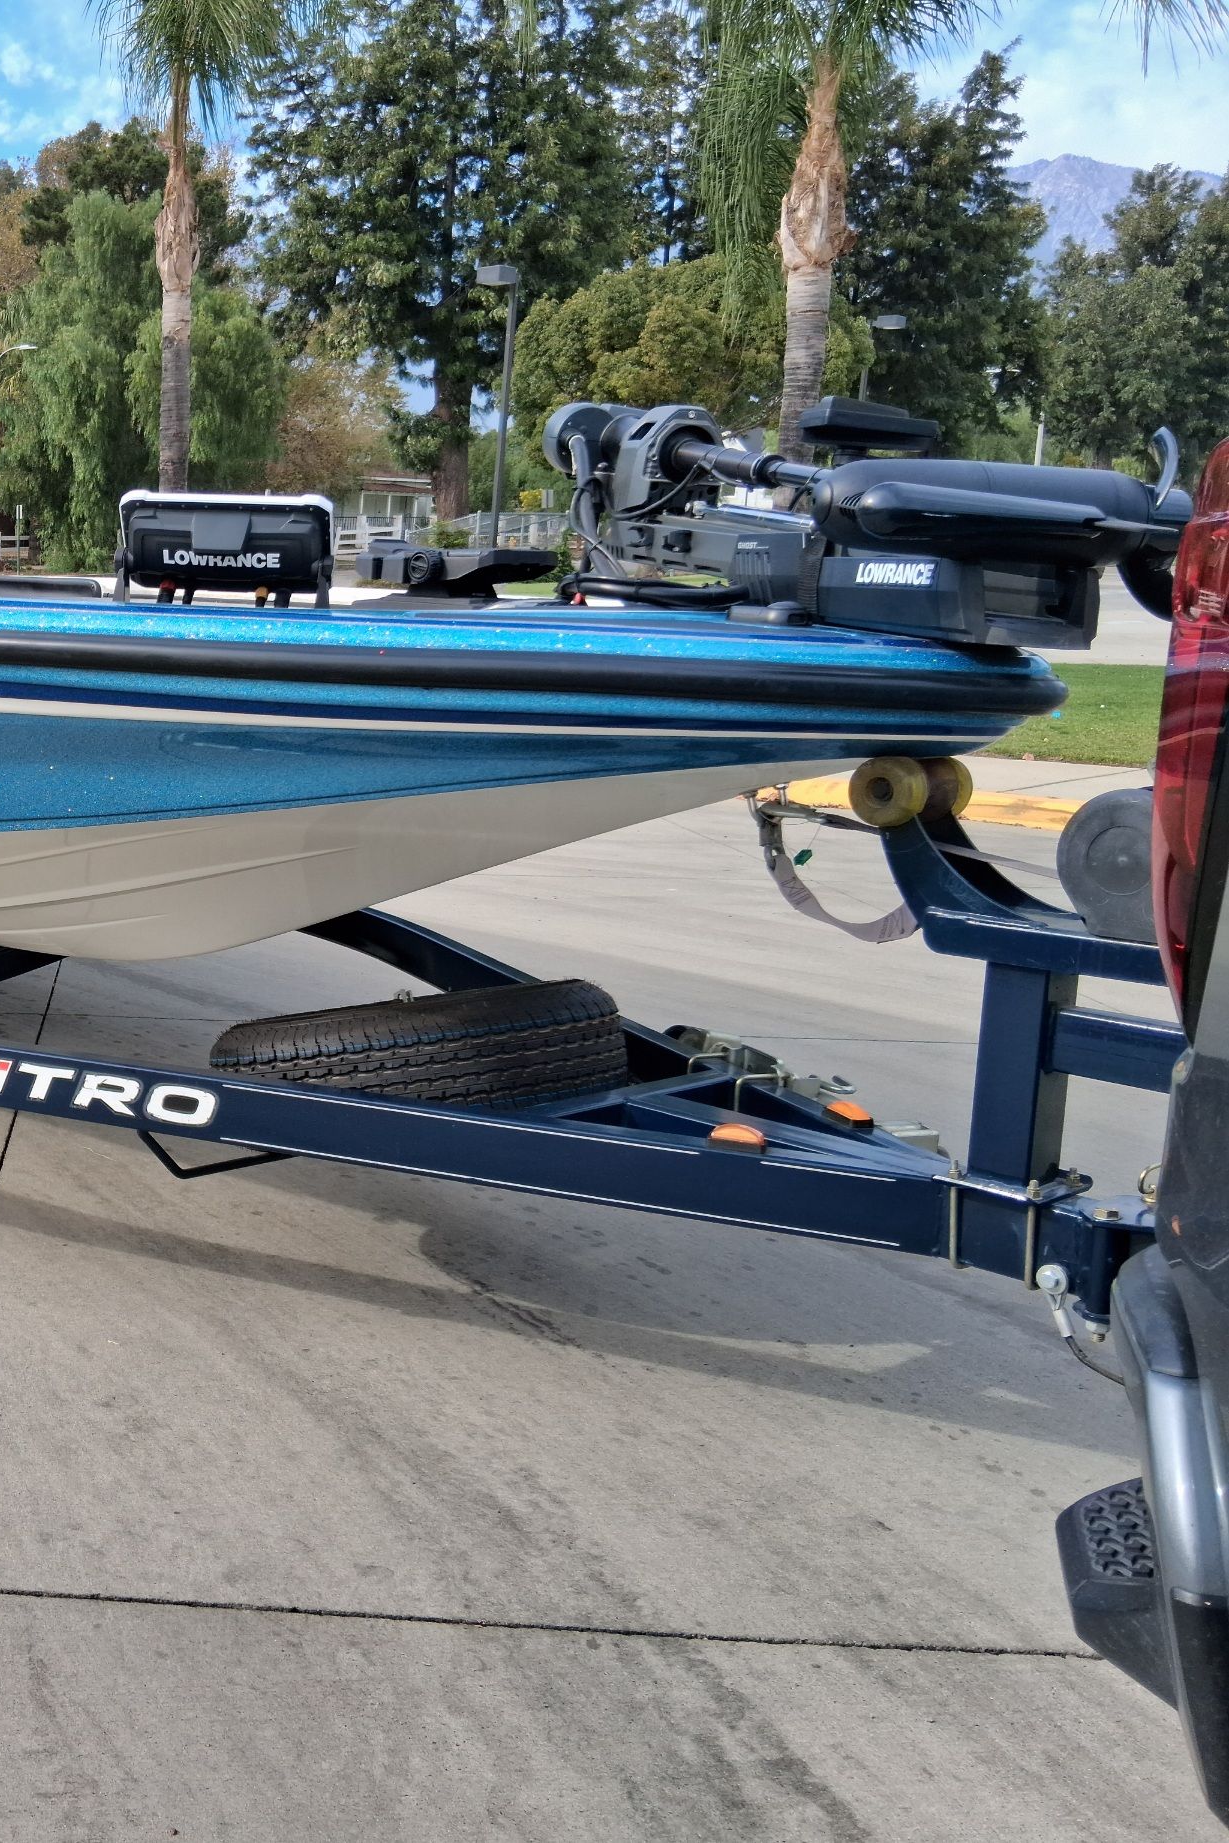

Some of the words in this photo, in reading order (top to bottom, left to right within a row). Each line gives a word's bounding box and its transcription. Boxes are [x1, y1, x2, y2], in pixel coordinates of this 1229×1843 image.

[737, 541, 758, 549] GHOST
[162, 549, 281, 569] LOWRANCE
[855, 562, 935, 585] LOWRANCE
